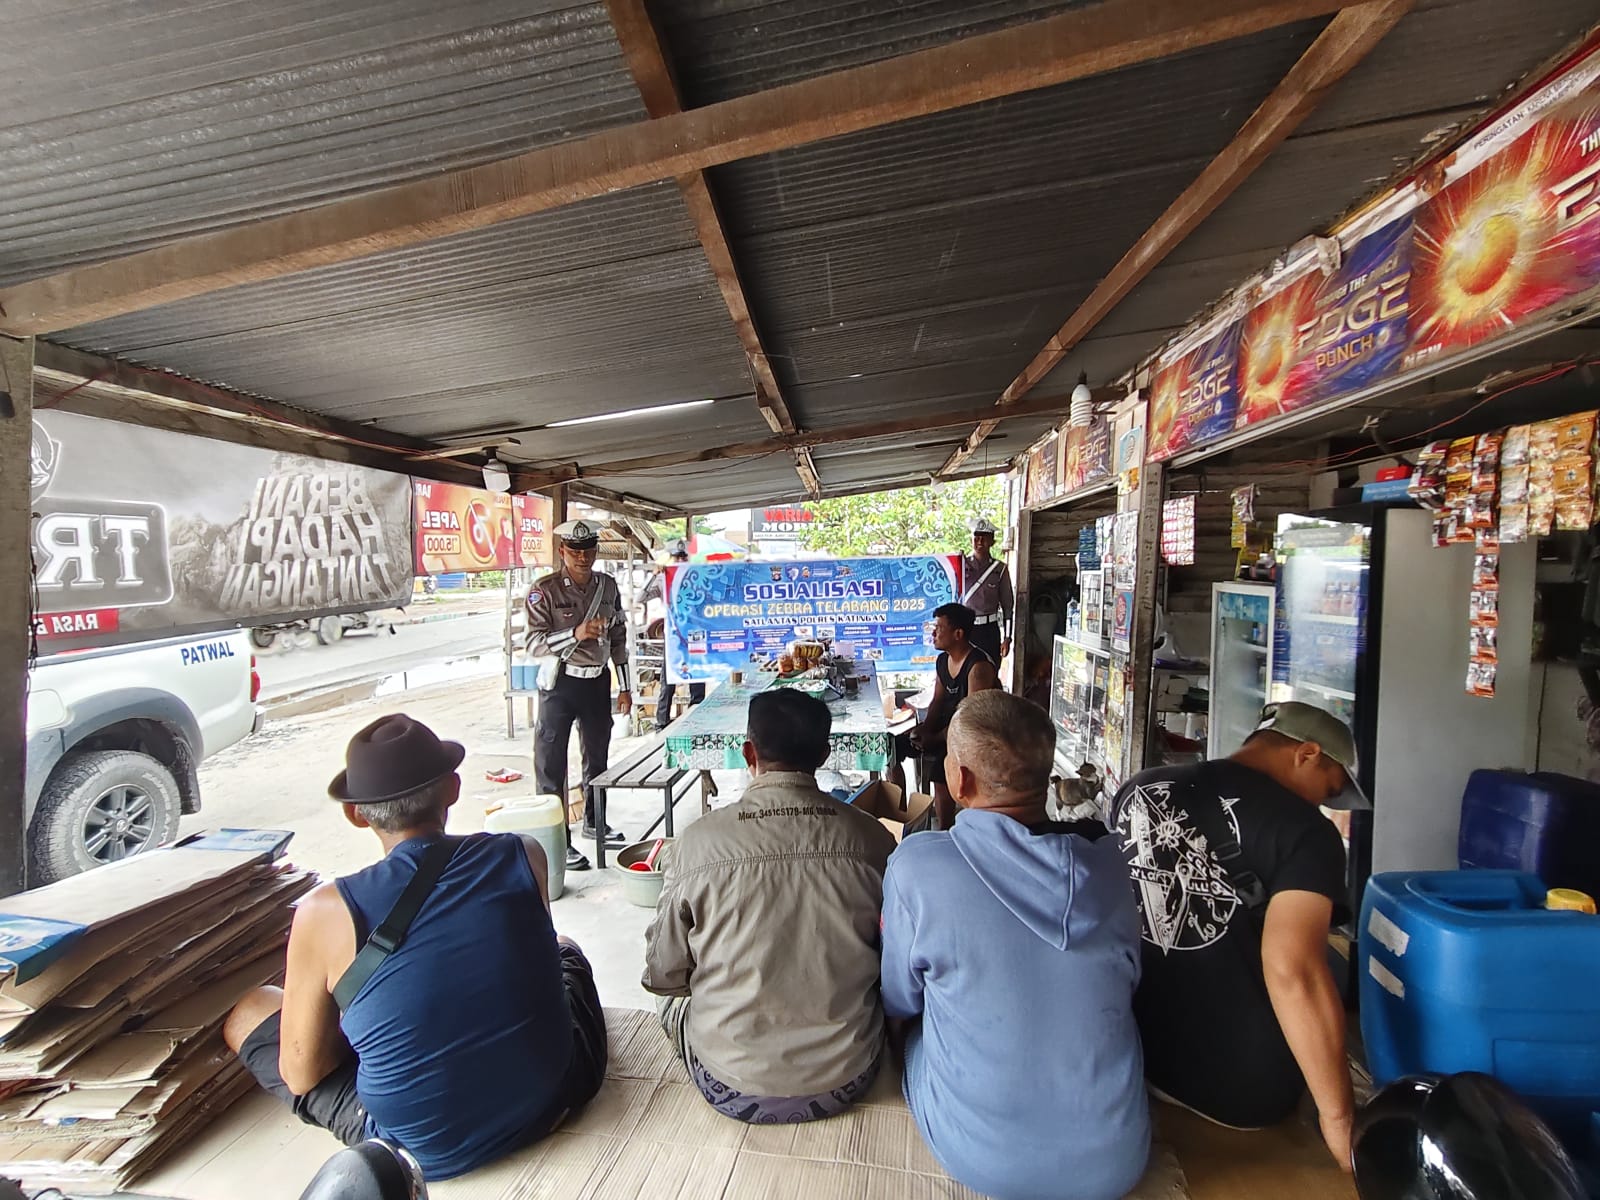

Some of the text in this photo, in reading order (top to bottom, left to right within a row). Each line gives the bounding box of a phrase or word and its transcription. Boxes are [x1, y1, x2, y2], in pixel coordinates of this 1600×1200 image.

[1298, 271, 1411, 351] EDGE
[1315, 333, 1374, 371] PUNCH
[1403, 343, 1443, 368] NEW
[1179, 364, 1232, 411] EDGE
[764, 508, 812, 522] VARIA
[745, 580, 882, 600] SOSIALISASI
[704, 599, 926, 618] OPERASI ZEBRA TELABANG 2025
[837, 613, 886, 623] KATINGAN
[181, 641, 235, 666] PATWAL
